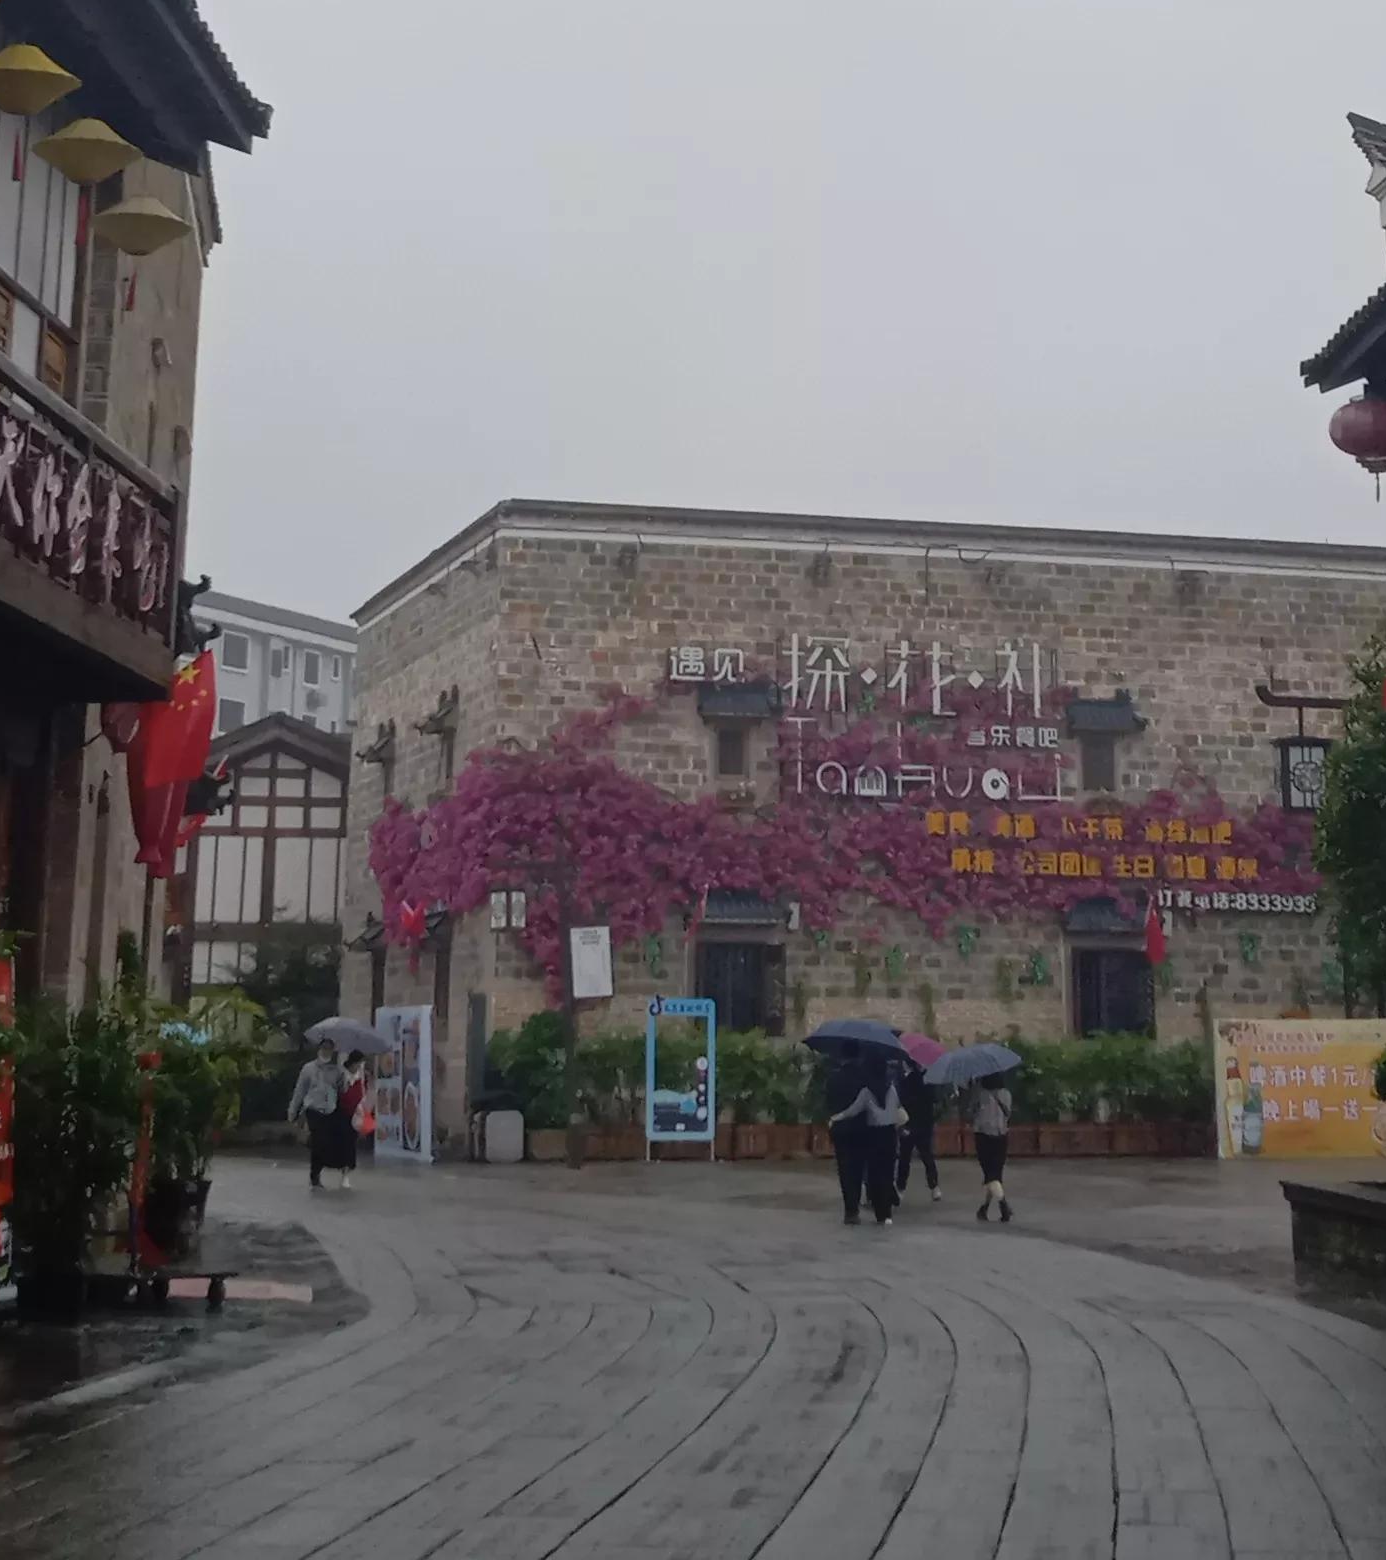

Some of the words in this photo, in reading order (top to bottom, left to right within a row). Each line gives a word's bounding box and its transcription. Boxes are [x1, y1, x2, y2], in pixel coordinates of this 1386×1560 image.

[670, 645, 746, 683] 遇见
[1112, 855, 1156, 879] 生日
[1248, 1063, 1380, 1088] 啤酒中餐1元/
